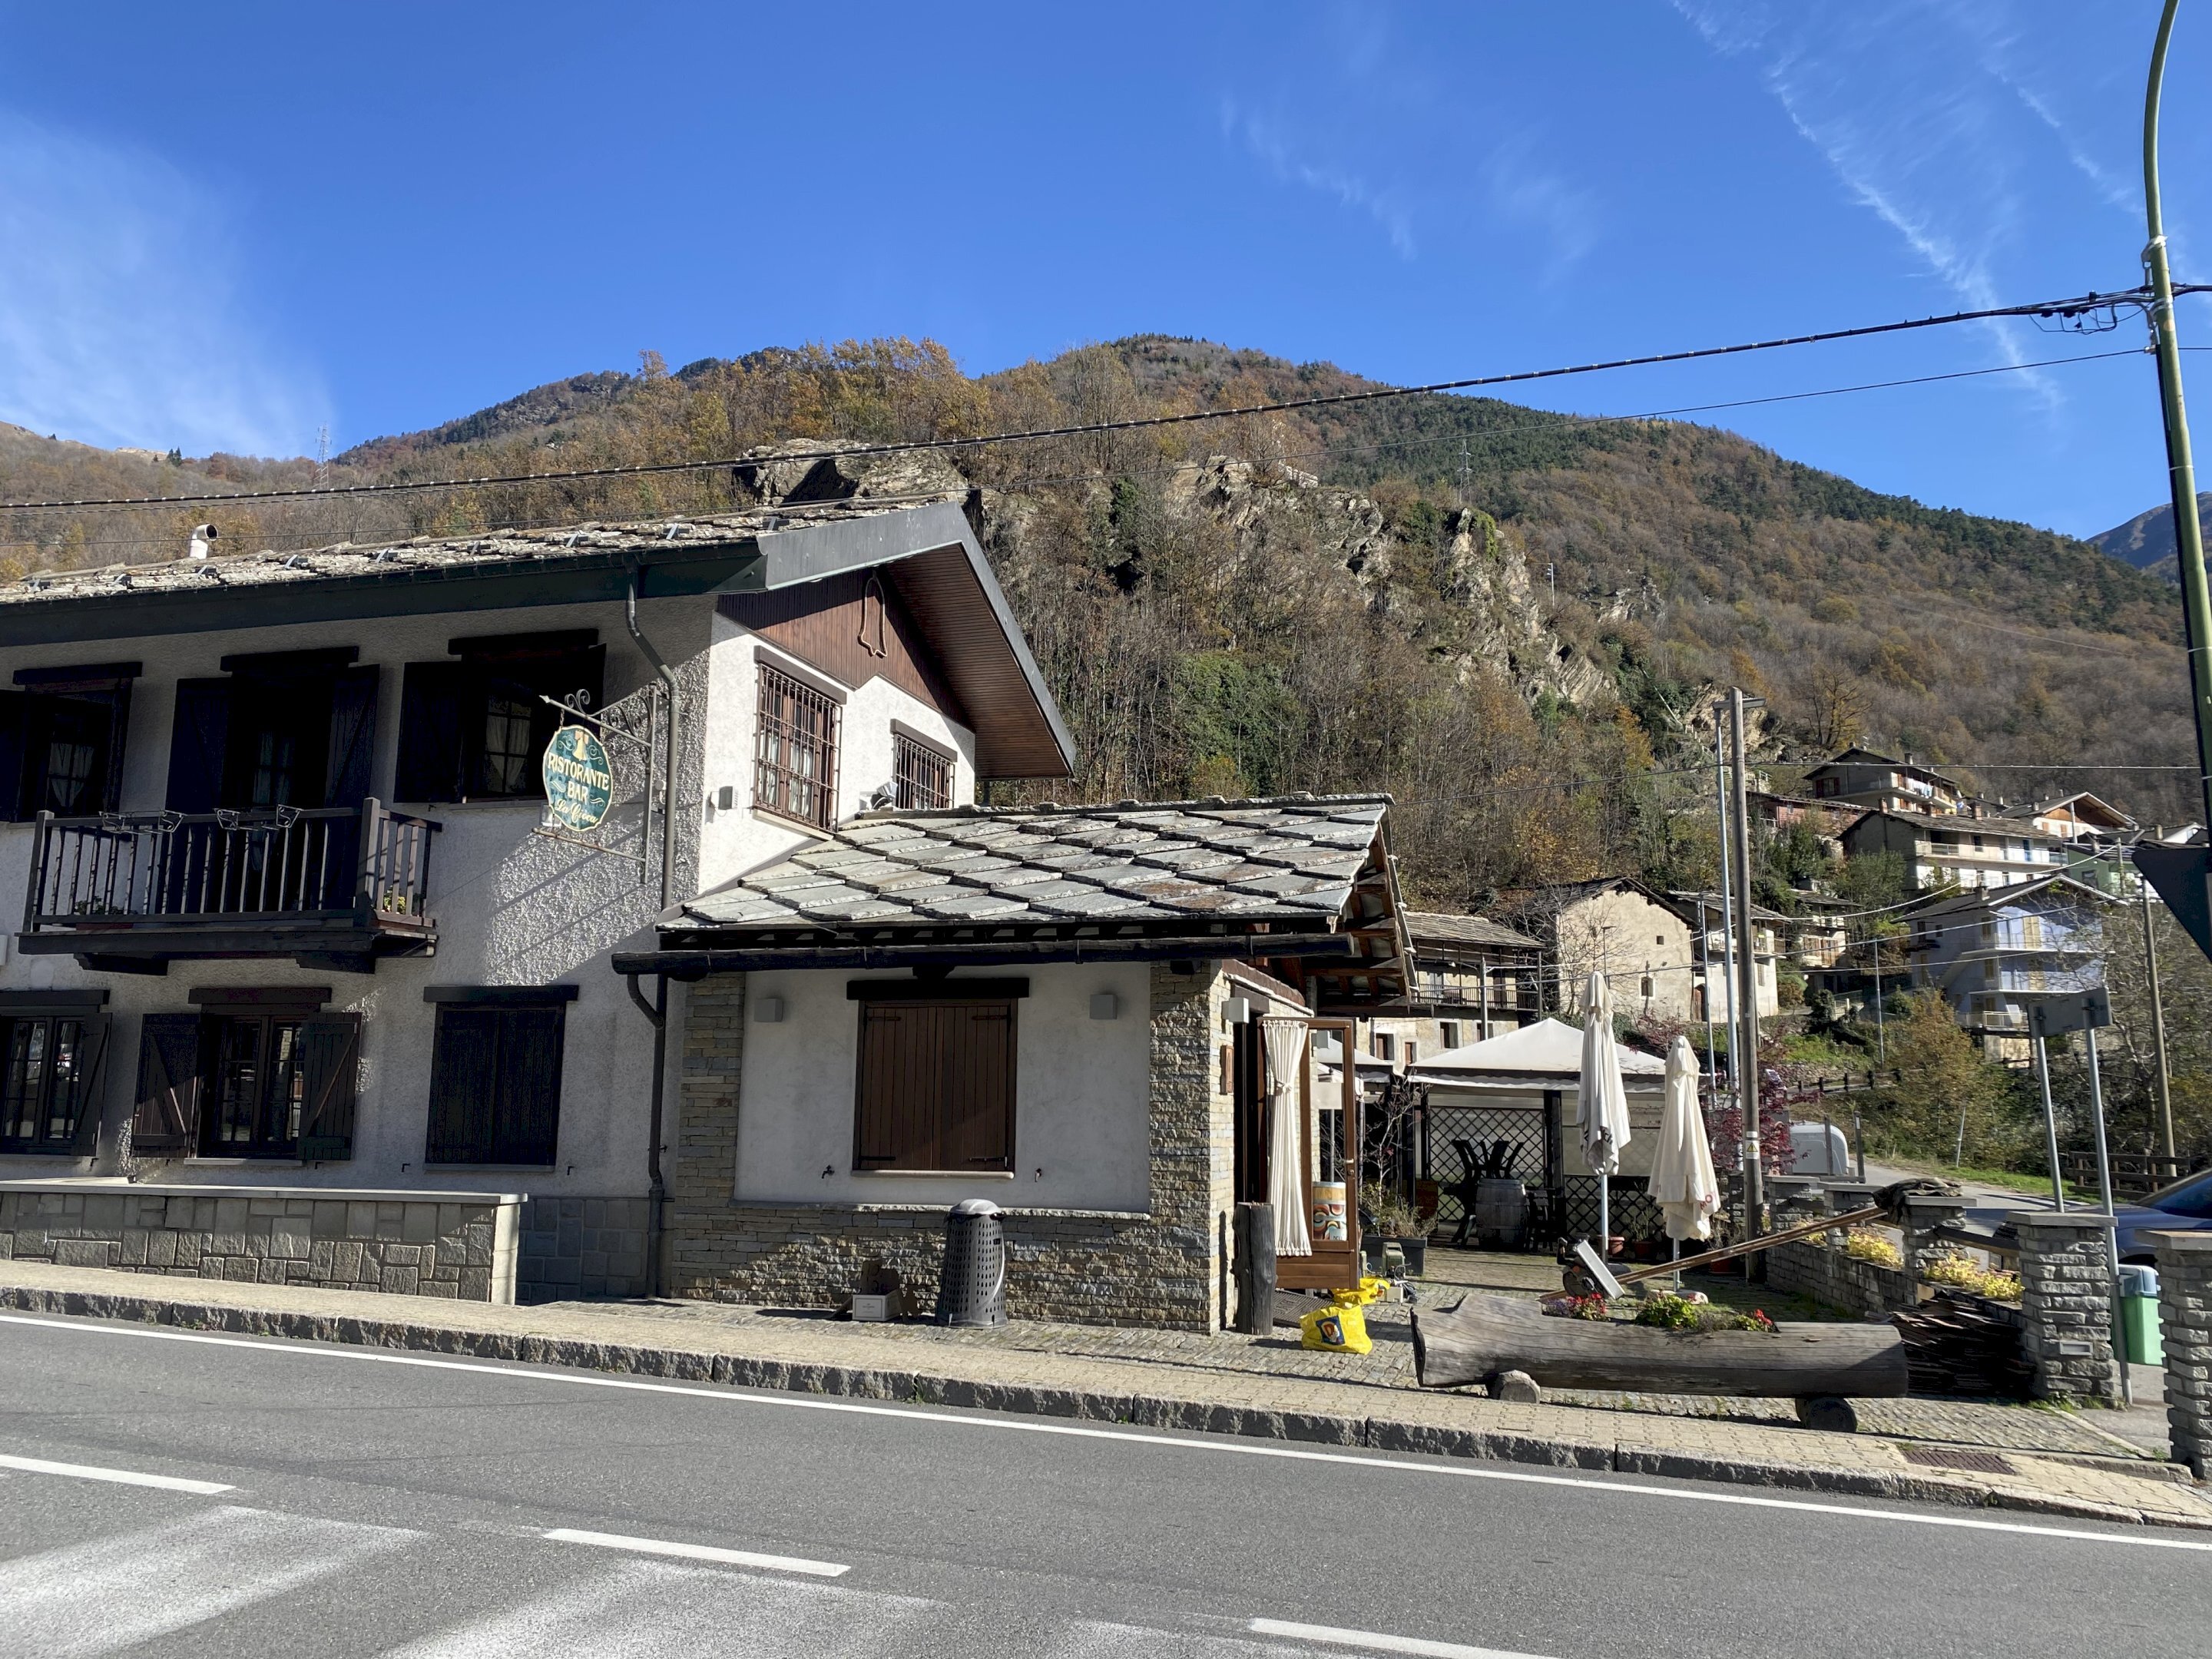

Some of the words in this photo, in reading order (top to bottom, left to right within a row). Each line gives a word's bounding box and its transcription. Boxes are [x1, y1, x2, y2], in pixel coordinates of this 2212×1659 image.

[548, 752, 610, 791] RISTORANTE
[555, 798, 570, 813] La
[568, 780, 588, 806] BAR
